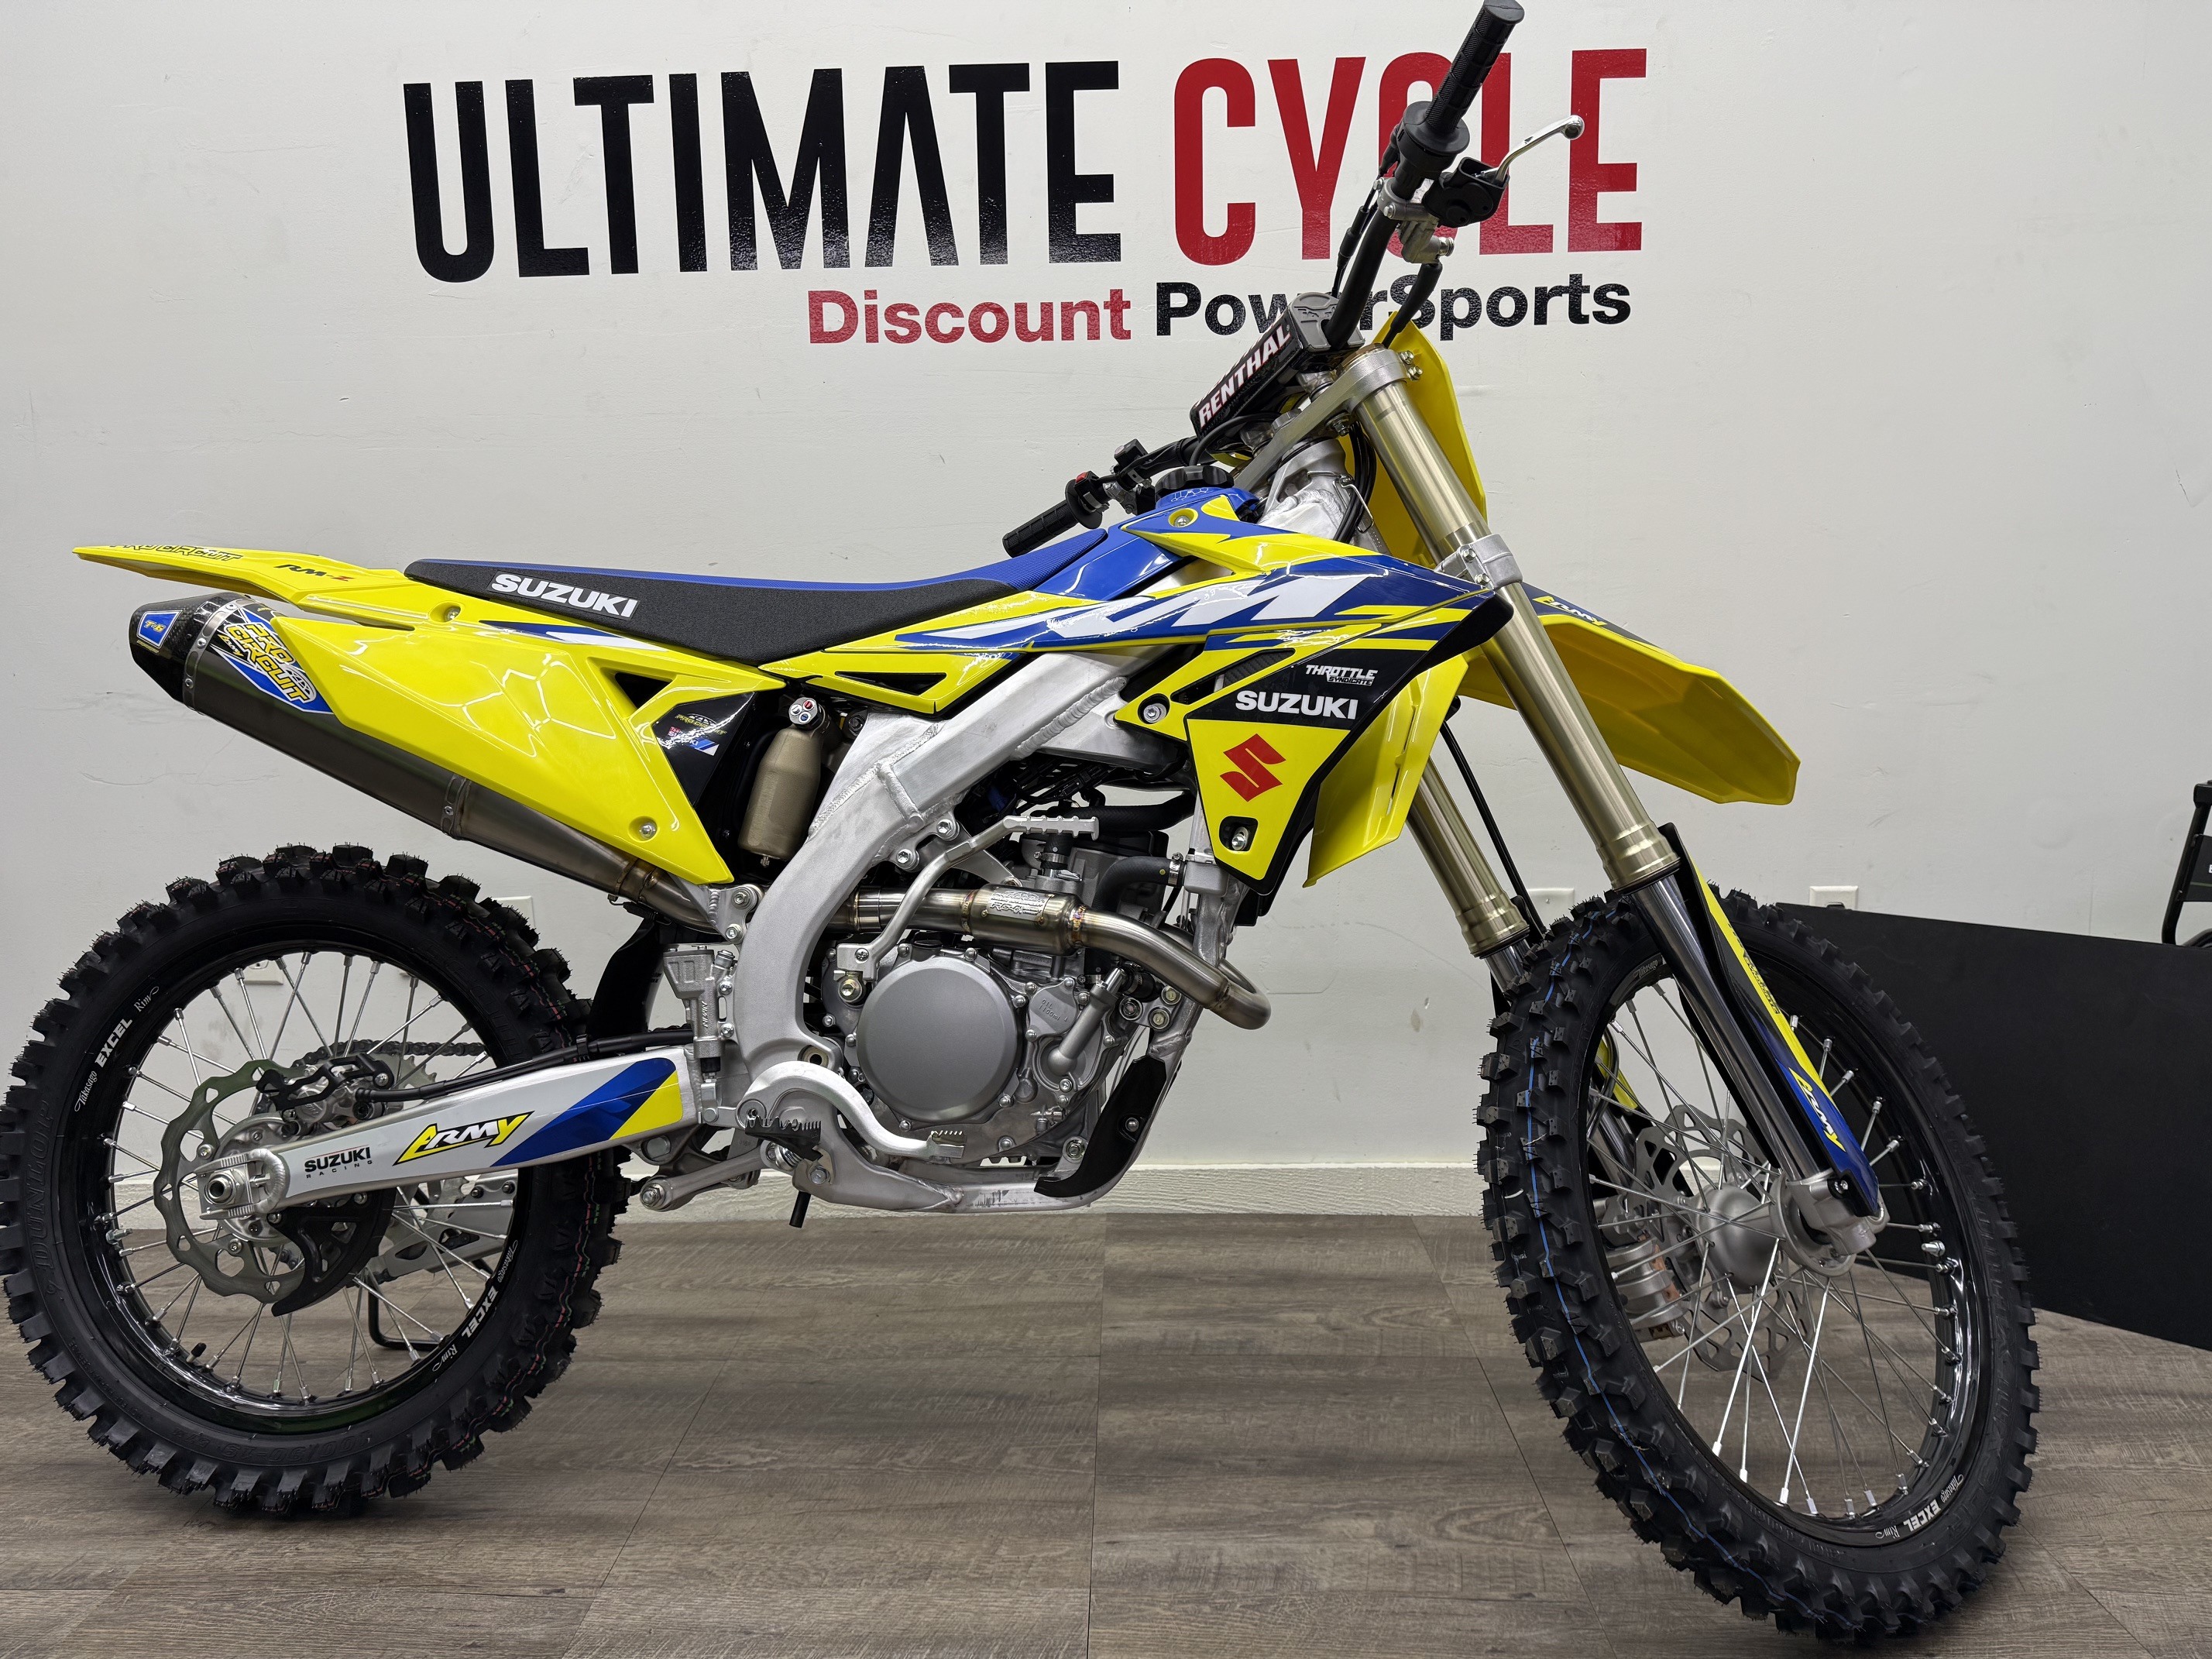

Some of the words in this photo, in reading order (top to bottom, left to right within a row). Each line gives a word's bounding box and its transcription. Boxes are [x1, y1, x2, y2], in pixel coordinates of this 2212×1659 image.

[403, 60, 1121, 283] ULTIMATE
[808, 289, 1132, 344] Discount
[1156, 273, 1631, 342] PowrSports
[1197, 325, 1291, 429] RENTHAL
[273, 564, 356, 581] RM-Z
[491, 573, 638, 618] SUZUKI
[243, 623, 297, 665] PRO
[225, 624, 311, 702] CIRCUIT
[1305, 664, 1379, 680] THROTTLE
[1328, 675, 1374, 686] SYNDICATE
[1235, 690, 1358, 720] SUZUKI
[74, 1070, 98, 1112] Takasago
[94, 1018, 132, 1068] EXCEL
[133, 986, 160, 1012] Rim
[393, 1111, 534, 1166] ARMY
[304, 1146, 372, 1173] SUZUKI
[306, 1160, 373, 1179] RACING
[497, 1239, 518, 1283] Takasago
[462, 1286, 499, 1338] EXCEL
[432, 1343, 459, 1372] Rim
[1940, 1474, 1964, 1503] Takasago
[1875, 1525, 1900, 1539] Rim
[1903, 1499, 1942, 1532] EXCEL
